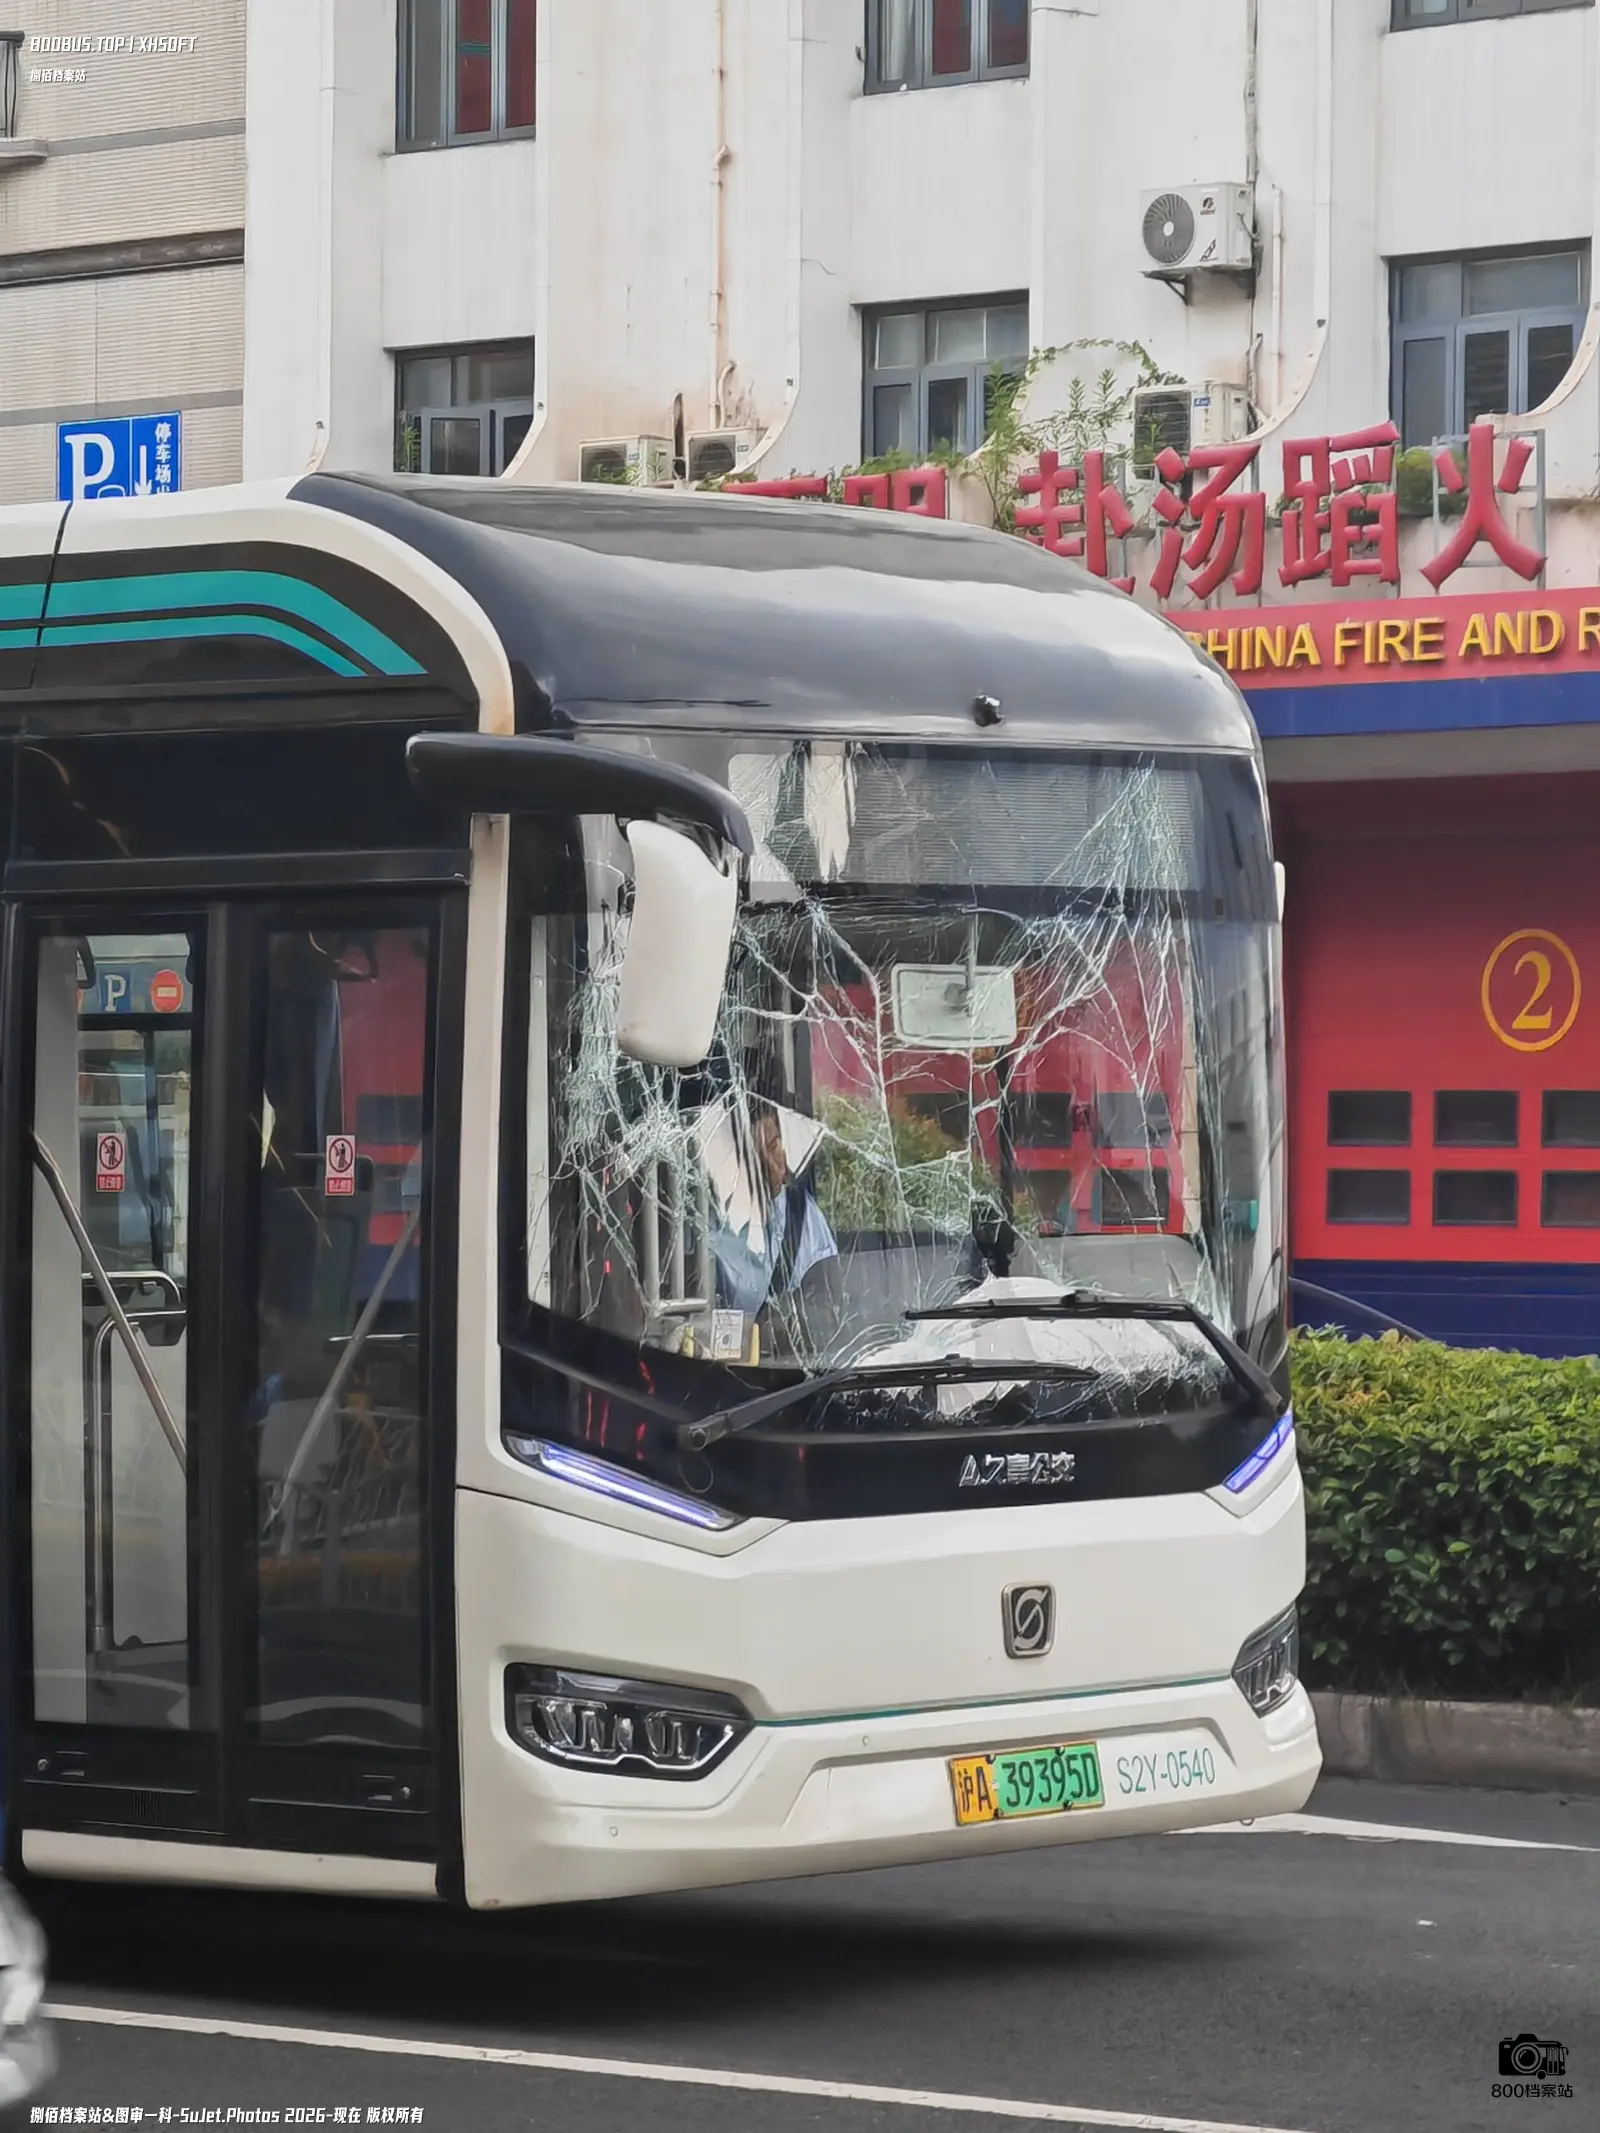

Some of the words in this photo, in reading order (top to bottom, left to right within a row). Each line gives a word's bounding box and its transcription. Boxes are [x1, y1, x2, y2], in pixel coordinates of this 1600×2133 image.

[64, 433, 115, 500] P
[1014, 420, 1547, 600] 赴汤蹈火
[1184, 622, 1322, 671] HINA
[1334, 616, 1446, 666] FIRE
[1458, 609, 1565, 657] AND
[104, 973, 127, 1012] P
[1511, 950, 1554, 1030] 2
[1001, 1752, 1099, 1808] 39395D
[1116, 1747, 1216, 1794] S2Y-0540
